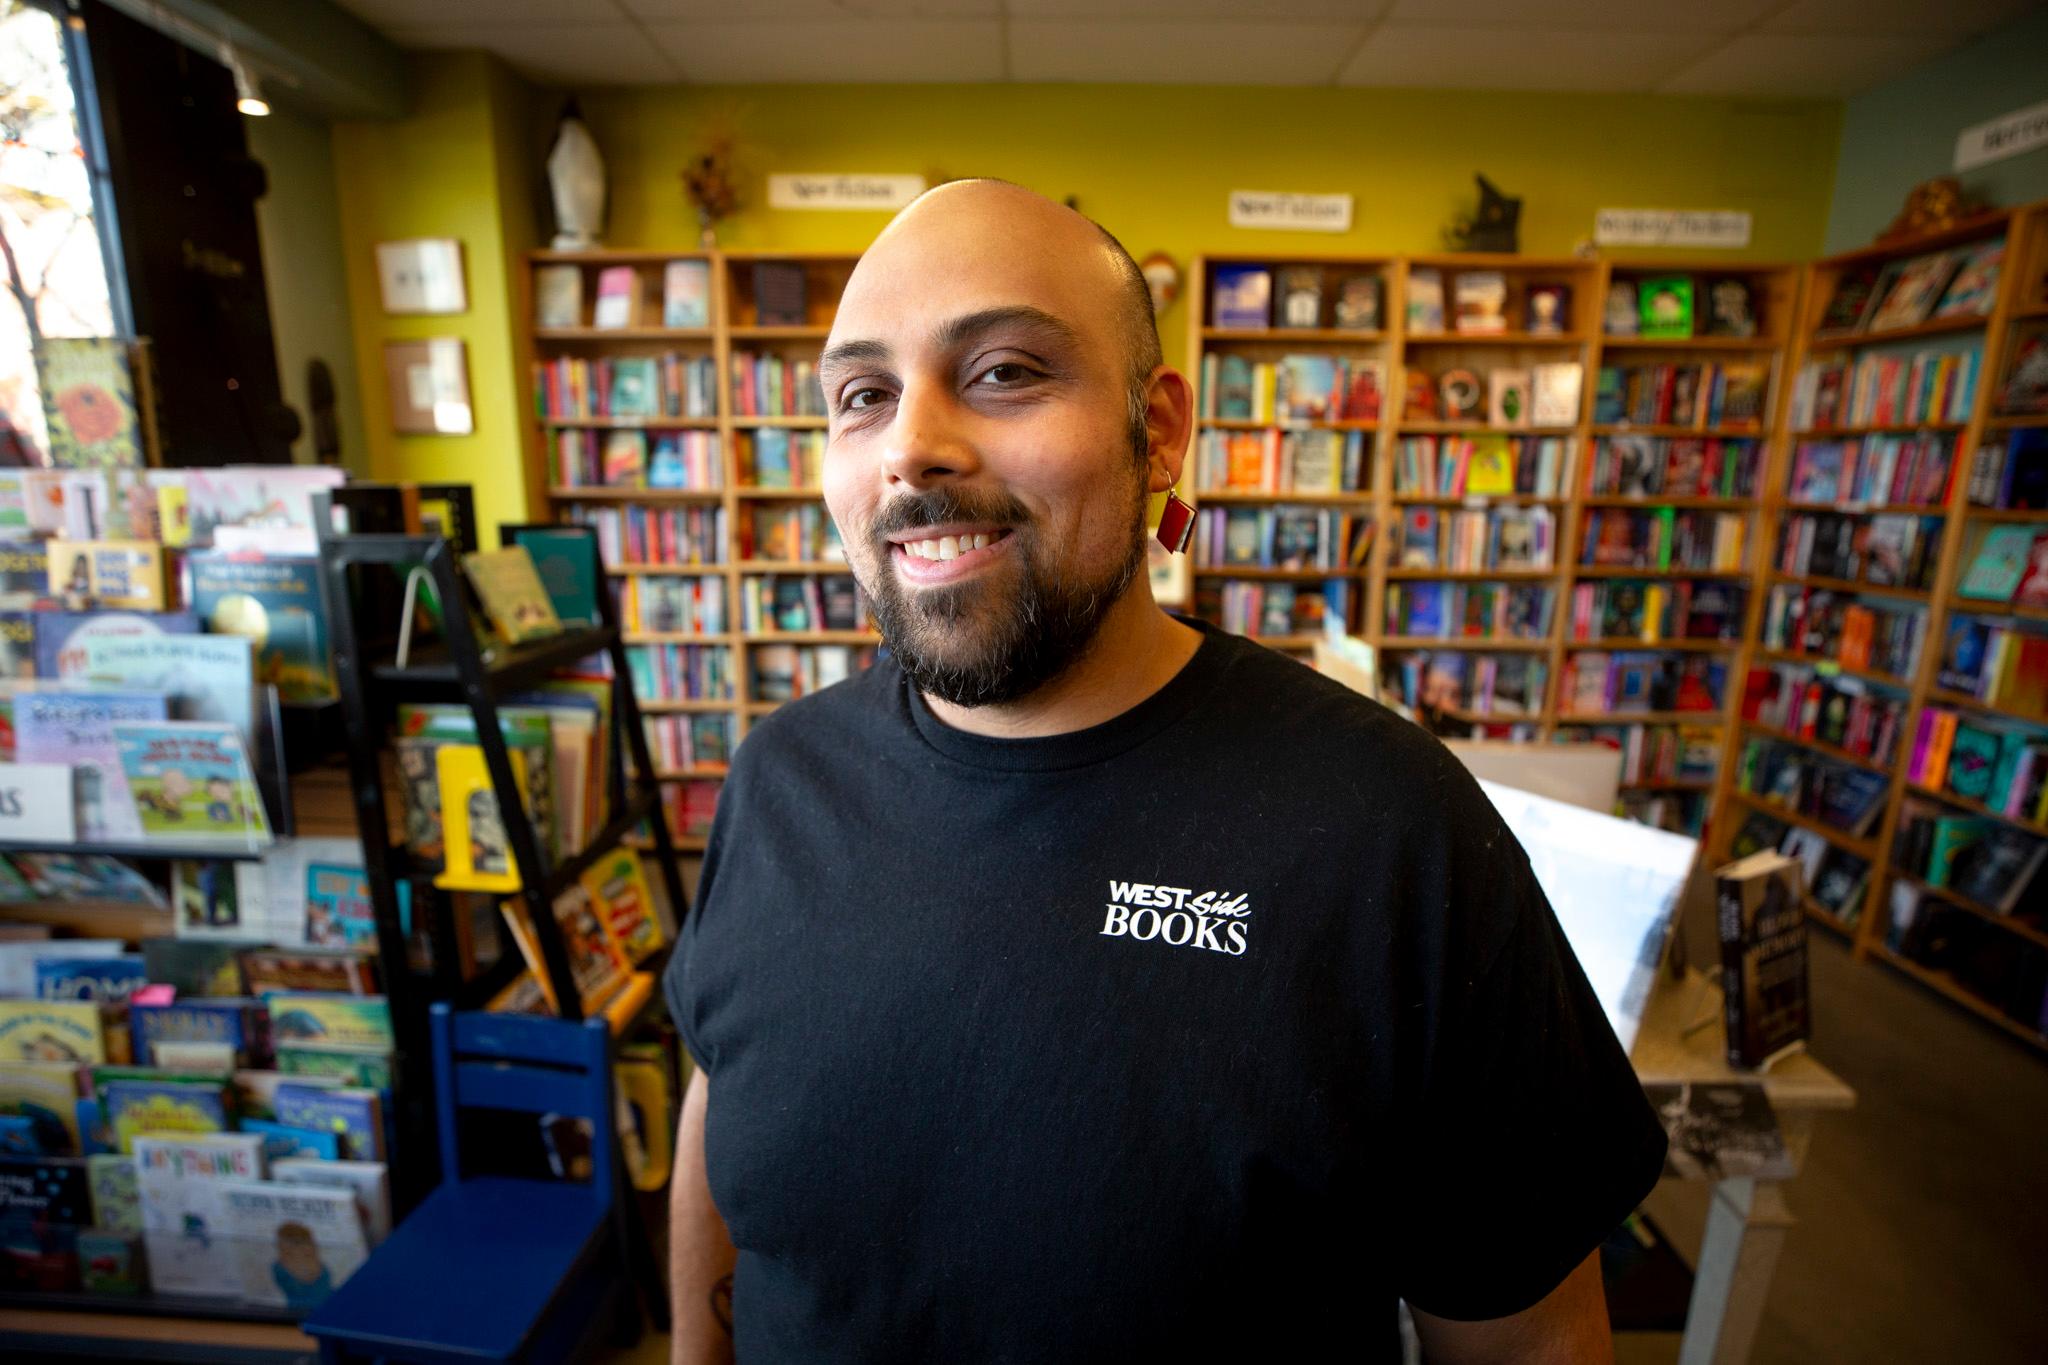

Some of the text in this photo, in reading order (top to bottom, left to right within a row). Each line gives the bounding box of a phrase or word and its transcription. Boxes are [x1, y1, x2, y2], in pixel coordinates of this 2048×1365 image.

[1109, 879, 1252, 917] WEST Side
[1099, 903, 1248, 956] BOOKS
